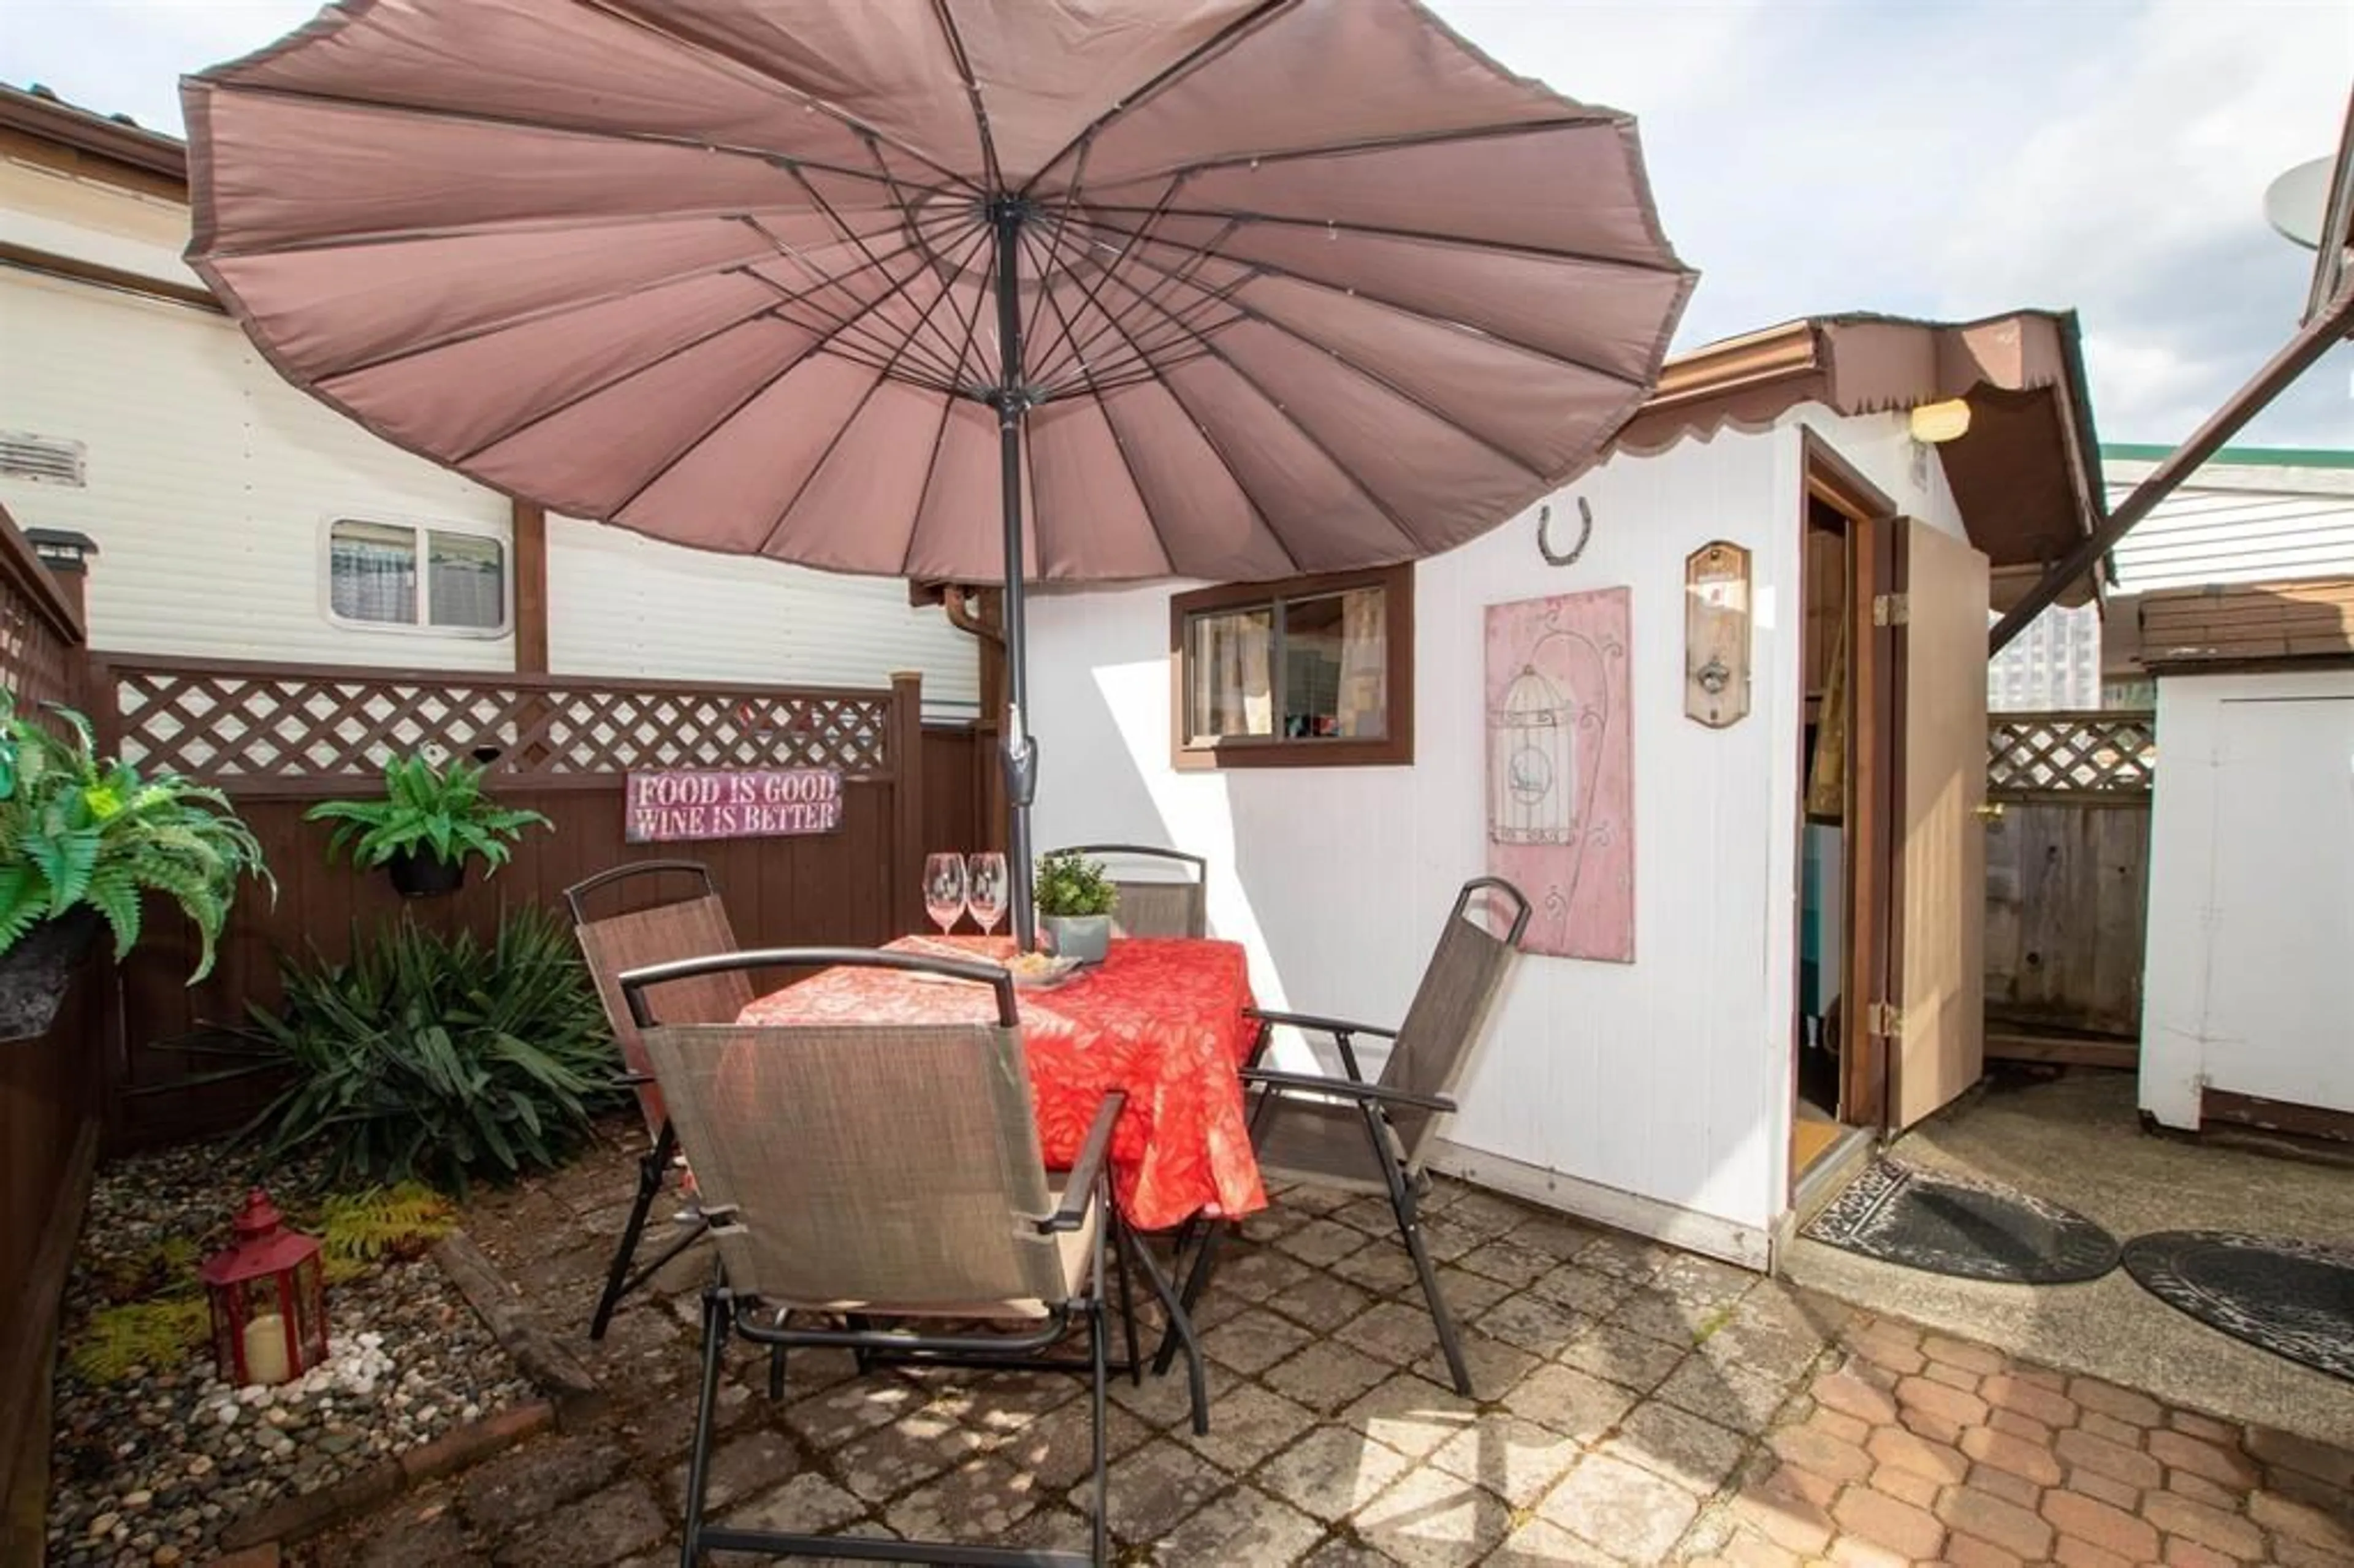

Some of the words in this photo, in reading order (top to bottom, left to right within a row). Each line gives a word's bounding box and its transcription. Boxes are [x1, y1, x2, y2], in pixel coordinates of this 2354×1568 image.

[639, 775, 720, 806] FOOD
[729, 775, 756, 804] IS
[764, 774, 836, 802] GOOD
[635, 805, 705, 837] WINE
[713, 805, 737, 834] IS
[744, 802, 836, 831] BETTER
